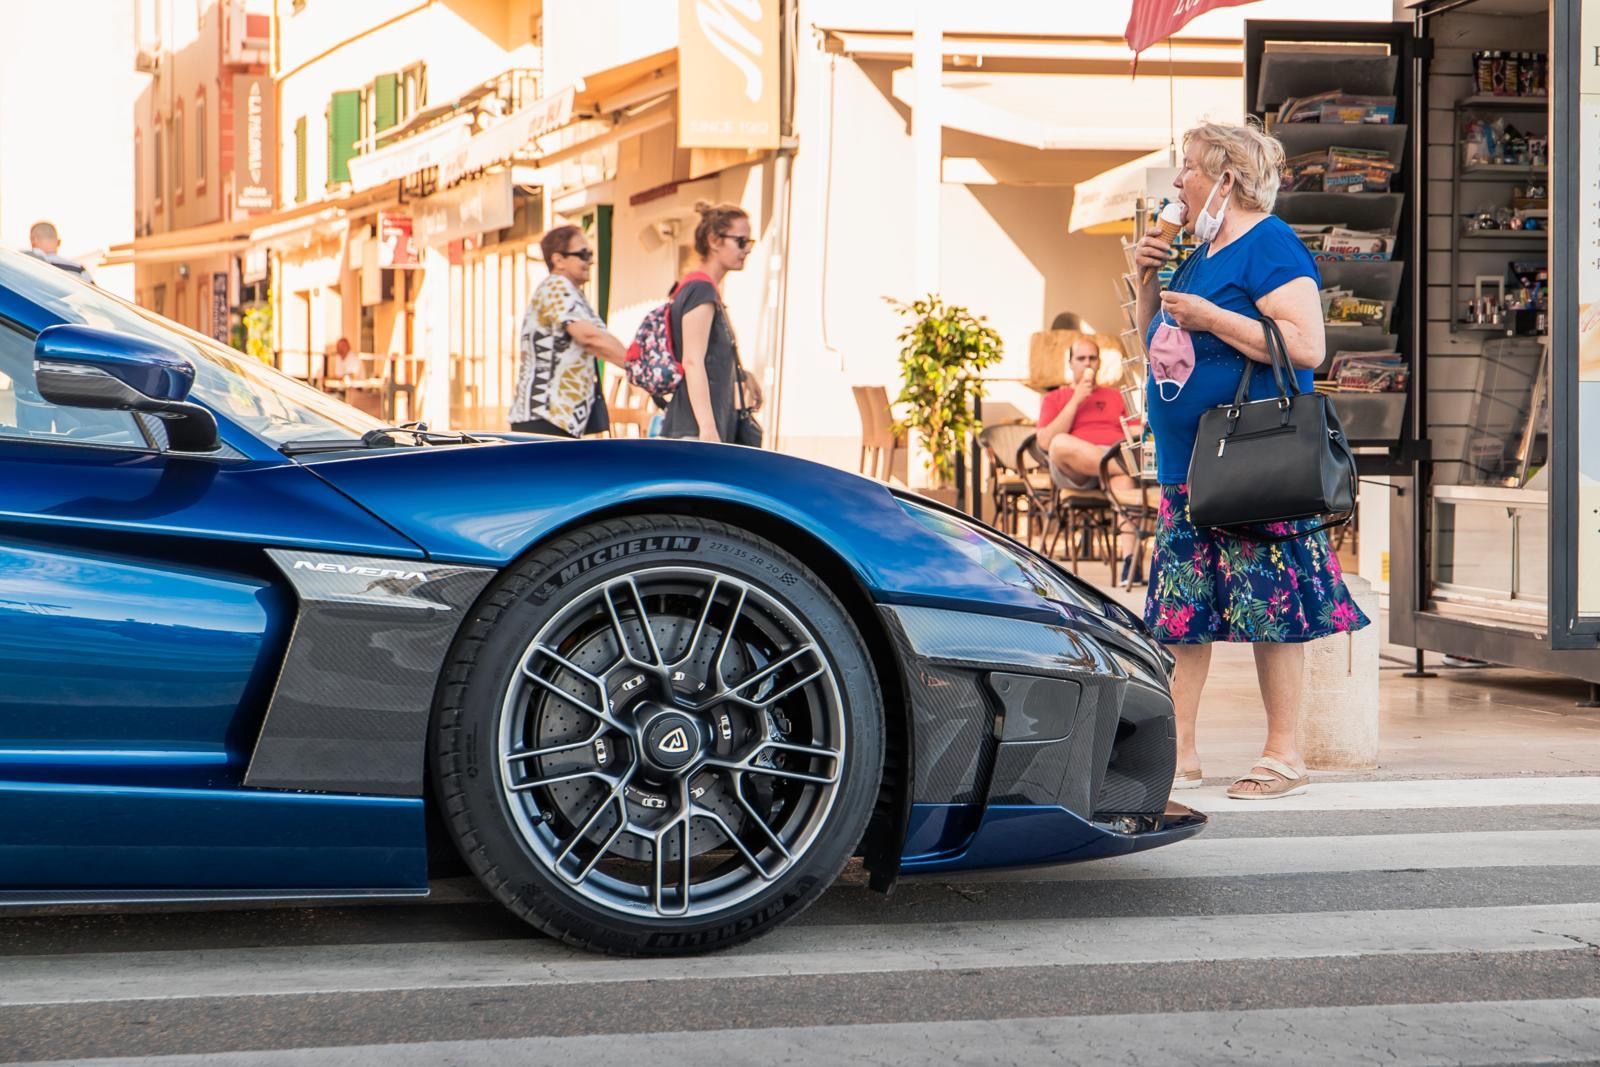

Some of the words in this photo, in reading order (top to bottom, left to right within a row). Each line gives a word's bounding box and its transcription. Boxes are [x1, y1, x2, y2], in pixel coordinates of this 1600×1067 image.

[293, 560, 428, 582] NEVERA
[560, 537, 692, 583] MICHELIN
[710, 541, 747, 558] 275/35
[750, 554, 765, 567] ZR
[766, 563, 779, 575] 20
